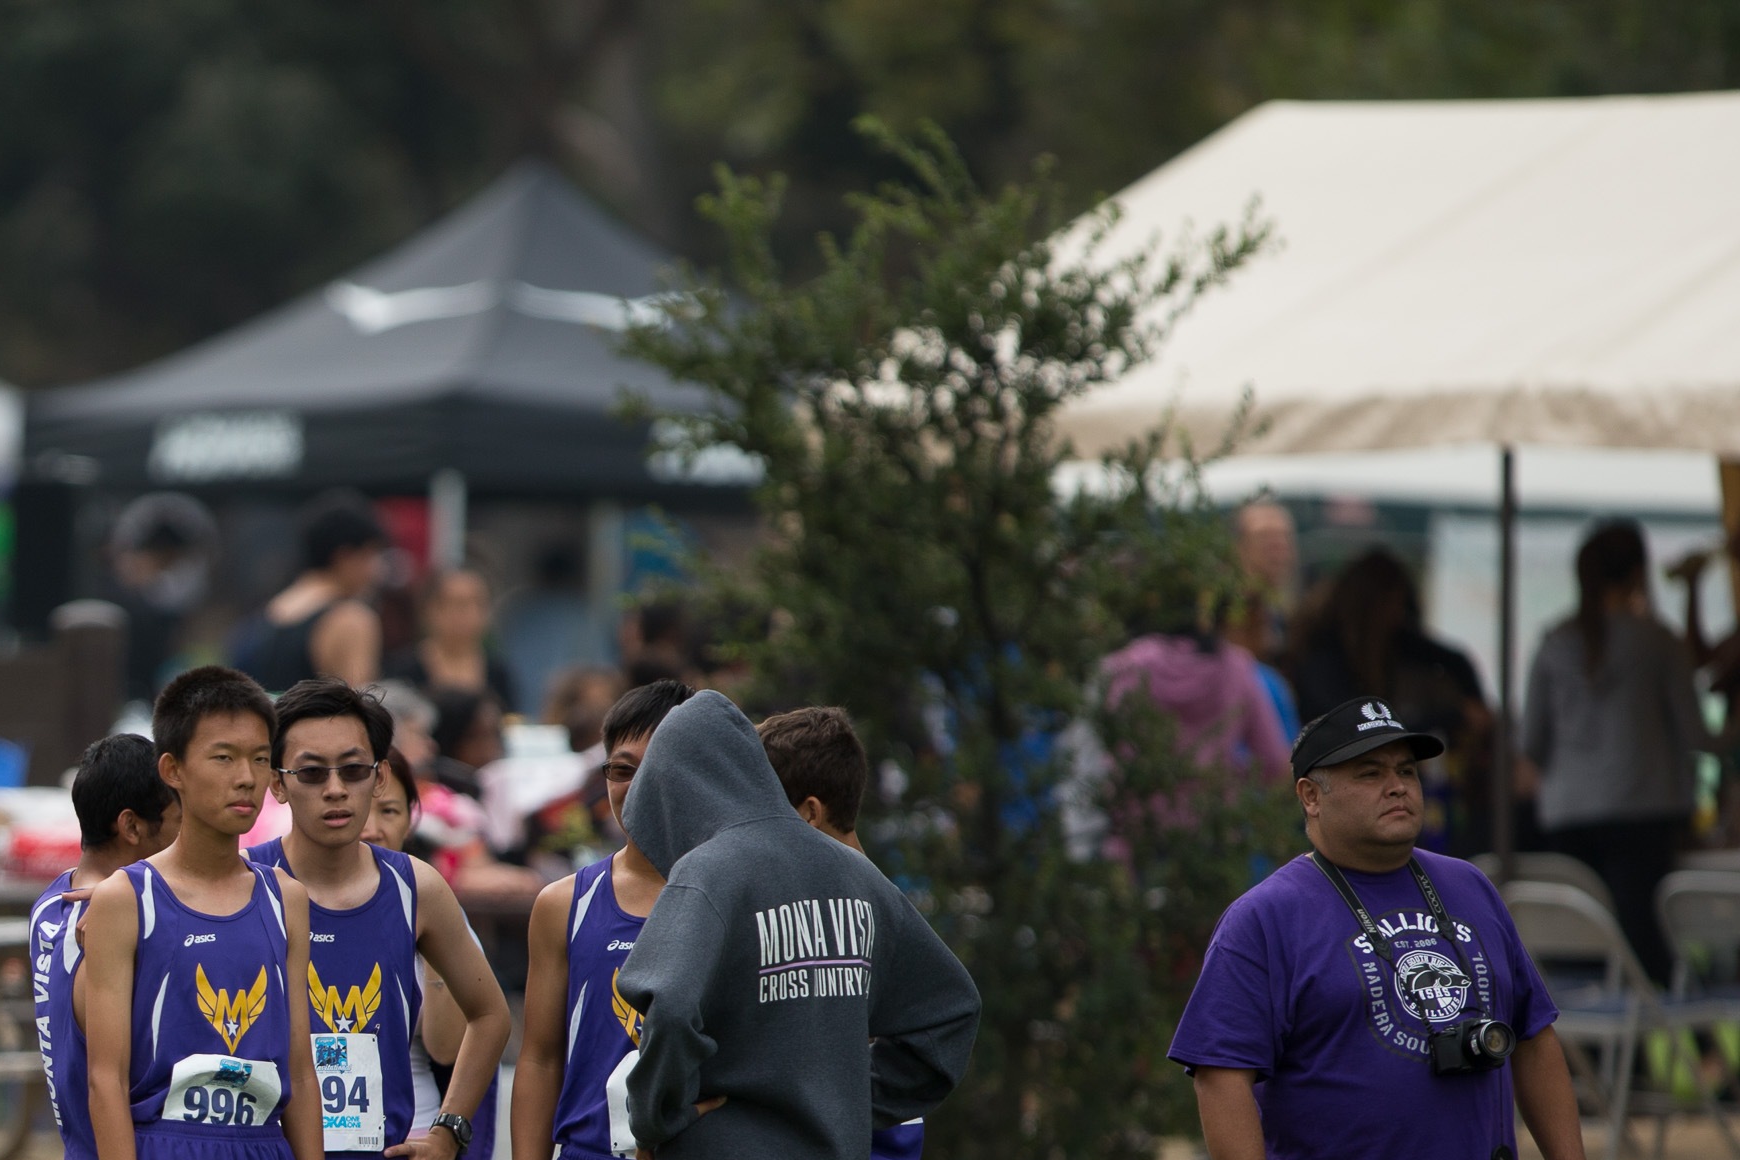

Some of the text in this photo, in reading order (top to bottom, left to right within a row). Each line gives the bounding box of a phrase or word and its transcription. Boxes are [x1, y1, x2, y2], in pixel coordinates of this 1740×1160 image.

[1418, 874, 1442, 914] COOLPIX
[1353, 912, 1472, 955] SALLIOS
[1356, 908, 1377, 934] Nikon
[34, 920, 64, 1004] VISTA
[1394, 940, 1413, 950] EST.
[759, 969, 809, 1004] CROSS
[1362, 961, 1431, 1055] MADERA SOU
[183, 1085, 258, 1127] 996
[321, 1075, 370, 1114] 94
